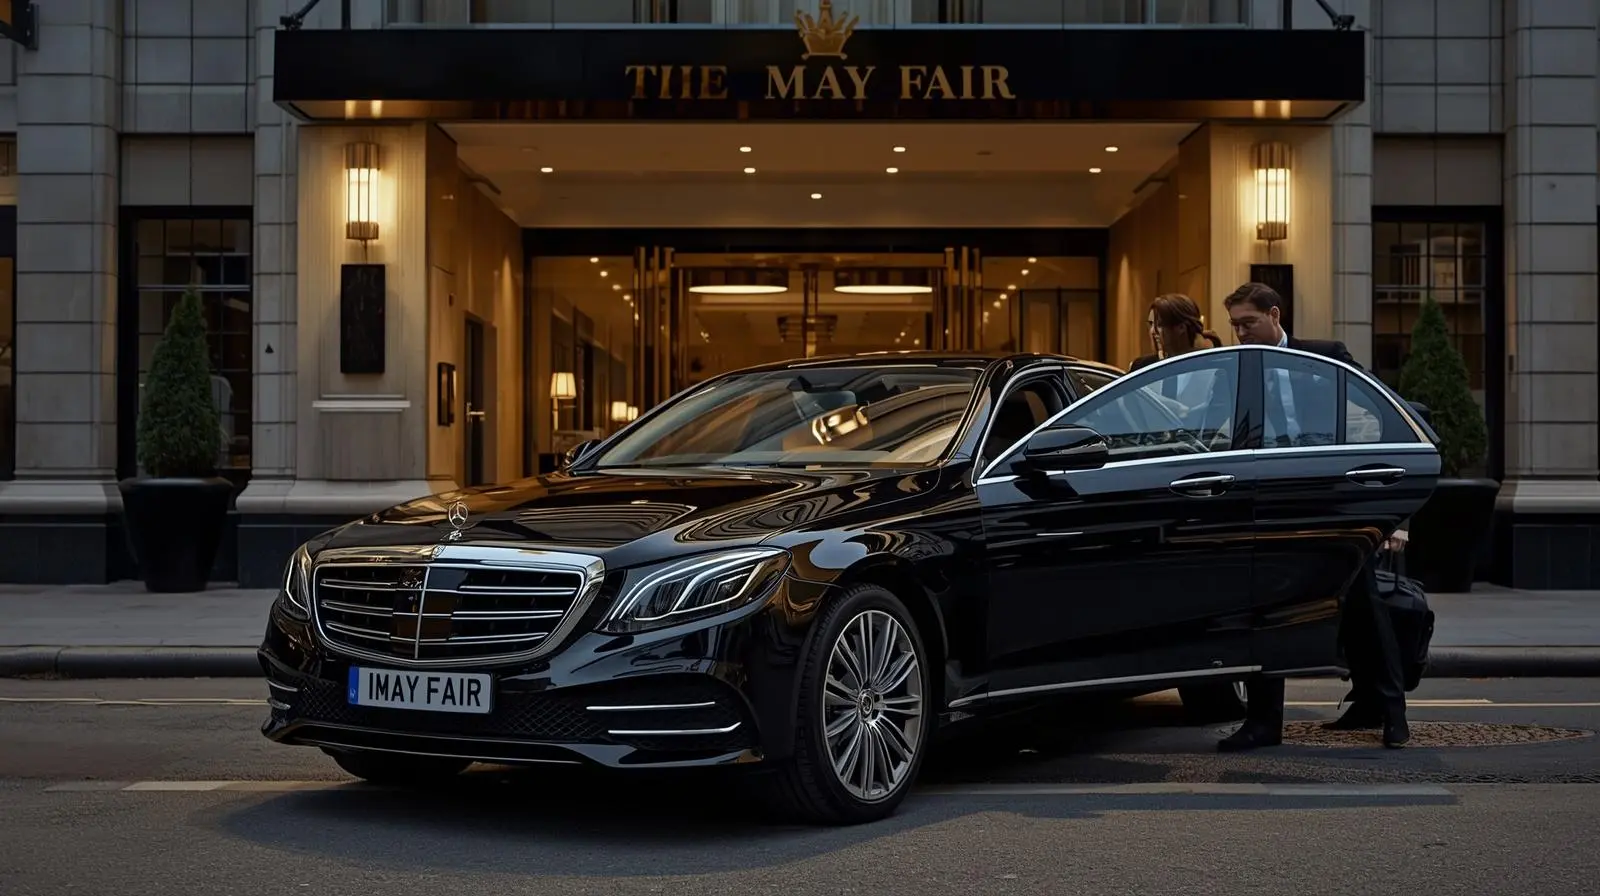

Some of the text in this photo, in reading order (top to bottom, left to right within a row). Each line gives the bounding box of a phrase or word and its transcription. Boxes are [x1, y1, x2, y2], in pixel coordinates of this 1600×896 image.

[765, 64, 876, 100] MAY
[898, 64, 1017, 100] FAIR
[426, 676, 482, 707] FAIR
